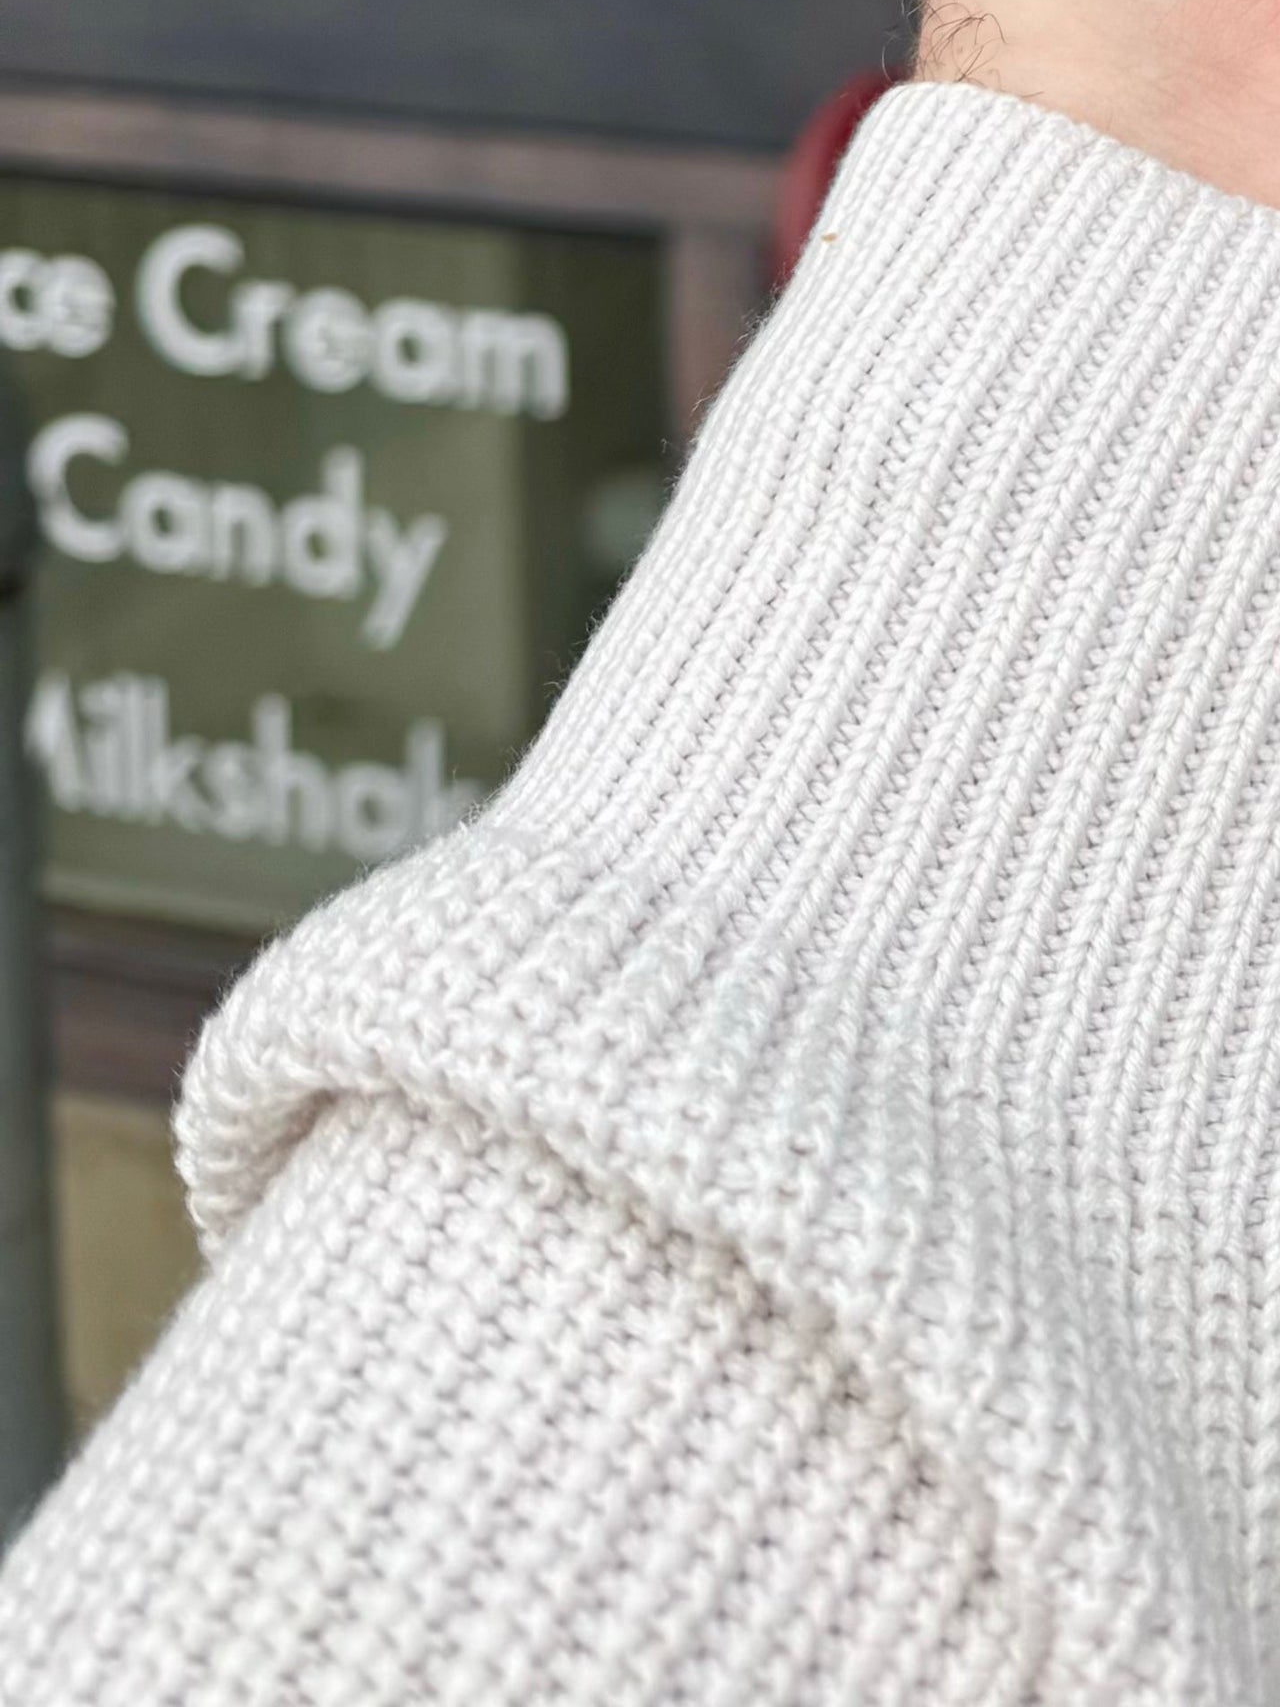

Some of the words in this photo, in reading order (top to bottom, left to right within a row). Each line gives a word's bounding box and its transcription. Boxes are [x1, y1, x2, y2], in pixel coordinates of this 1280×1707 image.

[136, 224, 568, 419] Cream
[28, 415, 446, 649] Candy
[24, 667, 492, 862] ilkshak
